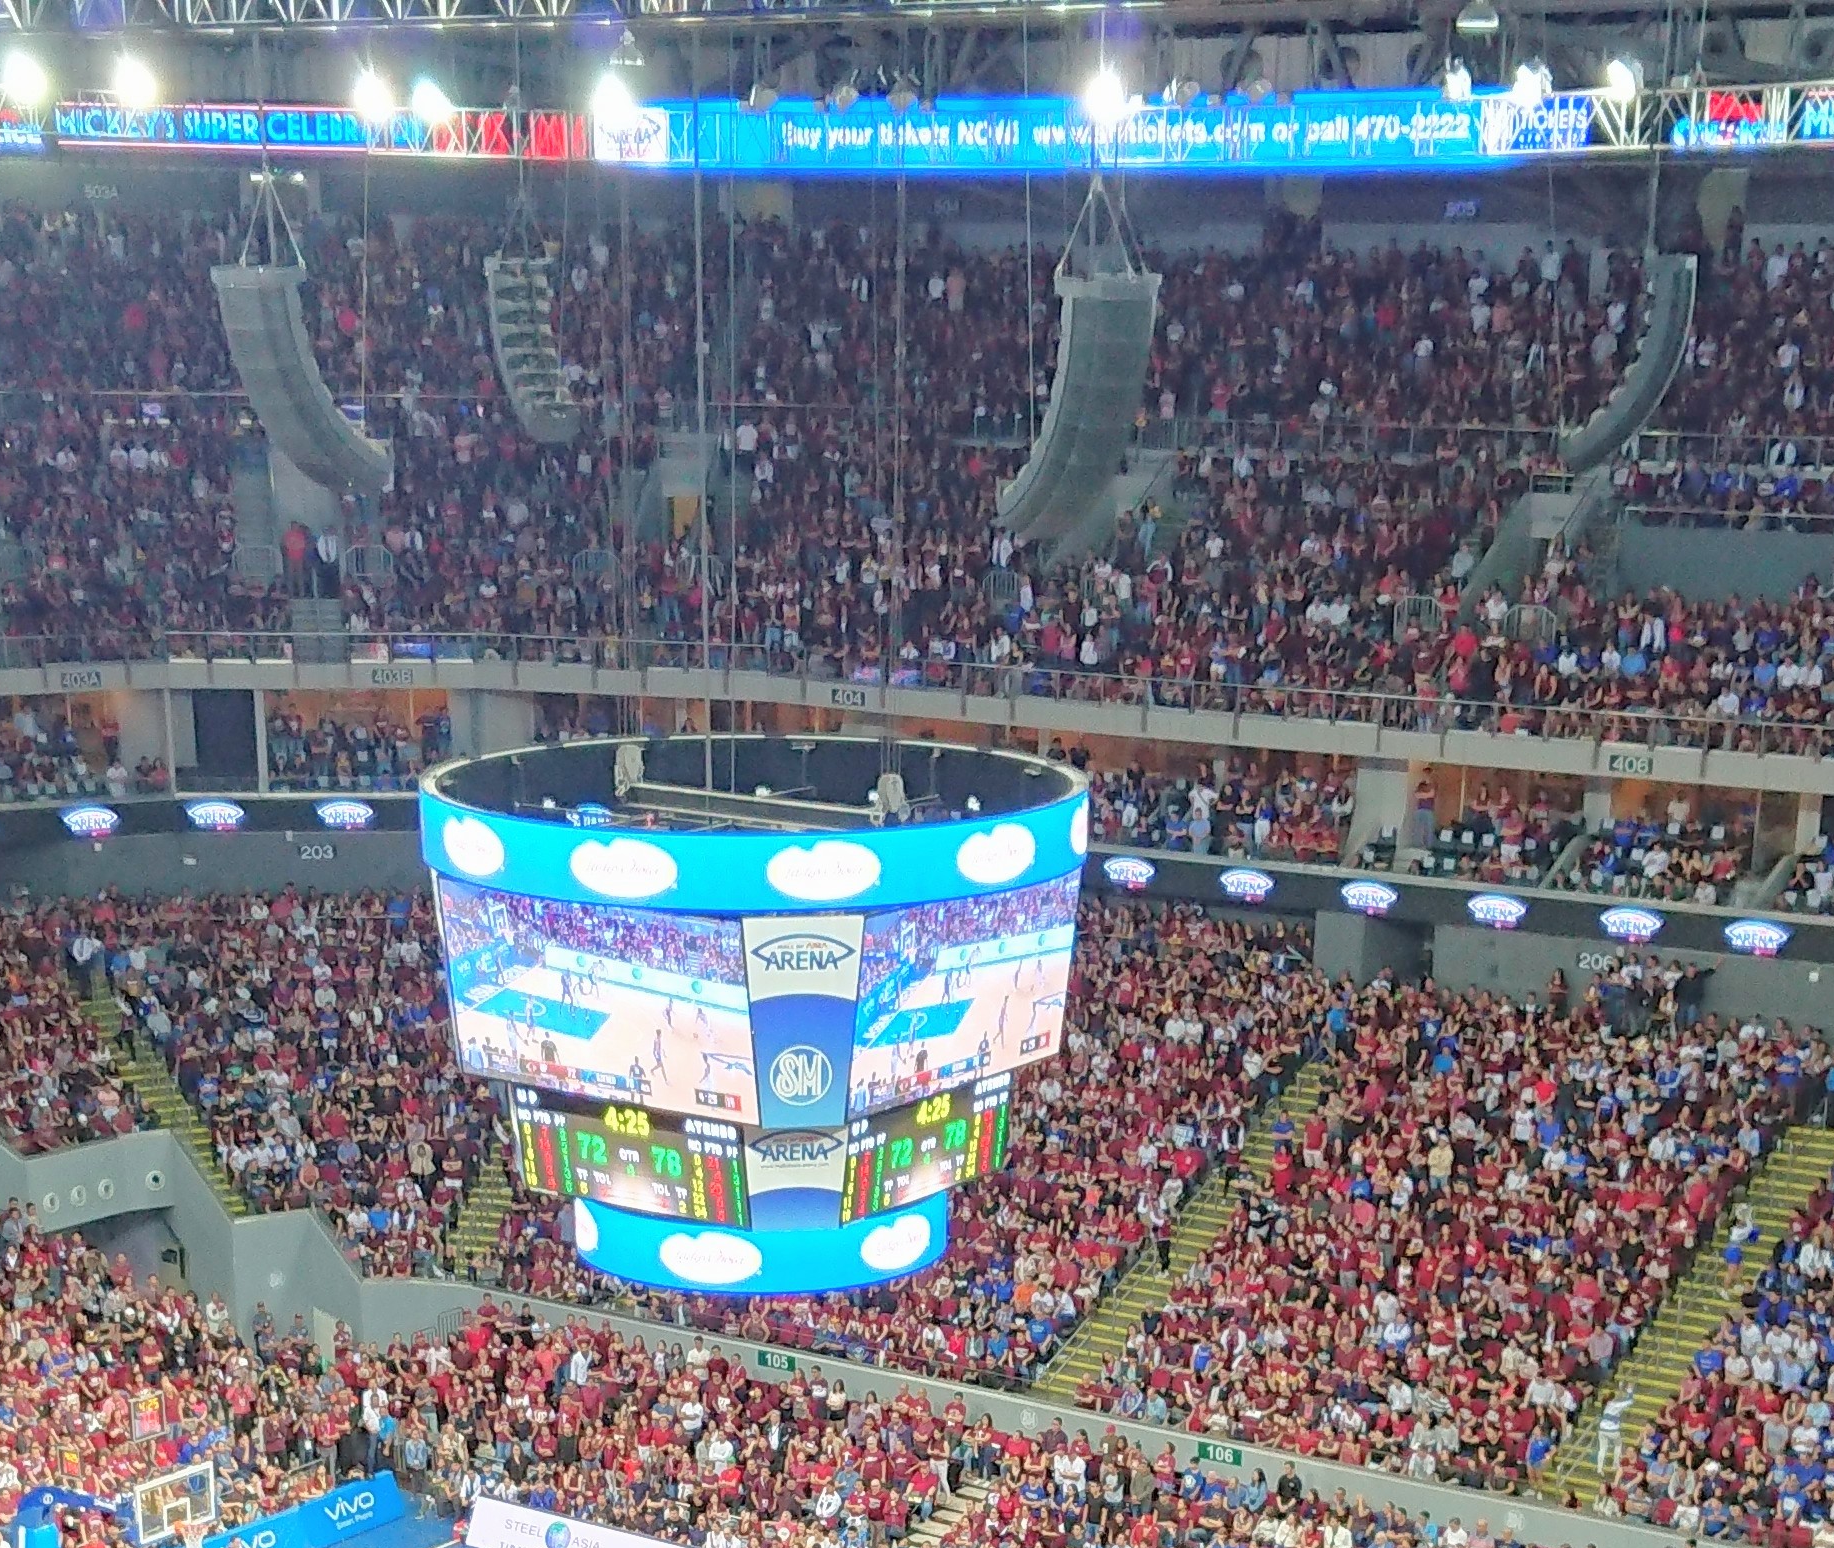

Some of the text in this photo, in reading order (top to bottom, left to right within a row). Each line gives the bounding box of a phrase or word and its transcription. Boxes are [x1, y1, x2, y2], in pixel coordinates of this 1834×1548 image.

[184, 110, 260, 141] SUPER
[1611, 756, 1652, 774] 406
[71, 816, 112, 831] ARENA
[195, 810, 237, 824] ARENA
[325, 811, 366, 823] ARENA
[300, 845, 335, 860] 203
[1226, 879, 1265, 894] ARENA
[1348, 893, 1388, 908] ARENA
[1476, 905, 1517, 921] ARENA
[1611, 919, 1652, 935] ARENA
[1732, 932, 1775, 949] ARENA
[764, 950, 839, 971] ARENA
[775, 1053, 822, 1098] SM
[916, 1093, 951, 1125] 4:25
[603, 1105, 651, 1139] 4:25
[943, 1119, 967, 1151] 78
[576, 1130, 608, 1164] 72
[761, 1142, 829, 1163] ARENA
[890, 1137, 914, 1169] 72
[650, 1144, 683, 1178] 78
[765, 1353, 789, 1370] 105
[1208, 1446, 1235, 1464] 106
[325, 1490, 375, 1522] vivo
[505, 1518, 543, 1539] STEEL
